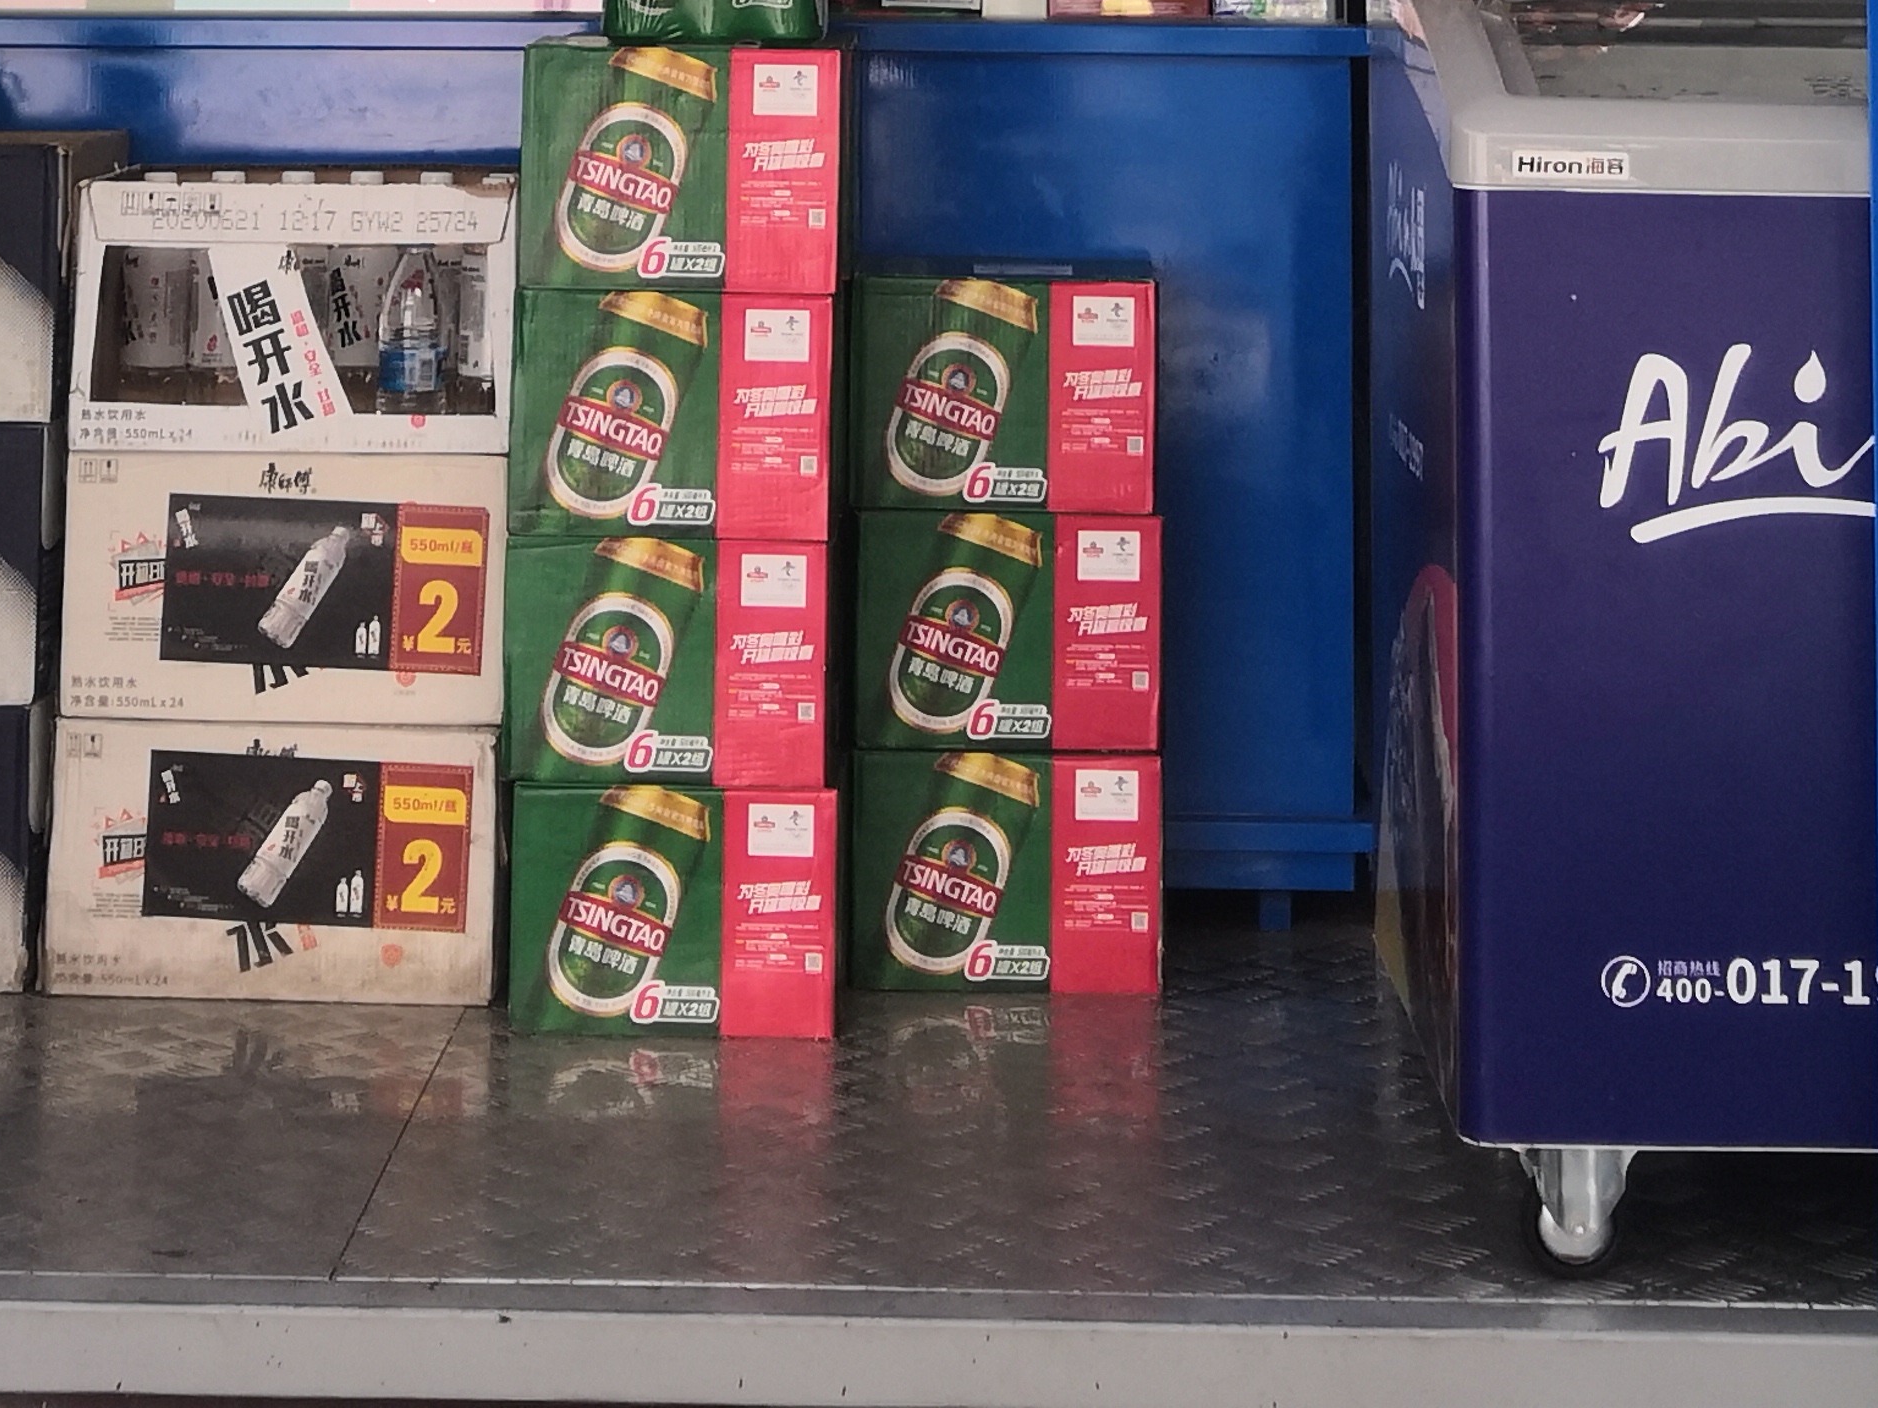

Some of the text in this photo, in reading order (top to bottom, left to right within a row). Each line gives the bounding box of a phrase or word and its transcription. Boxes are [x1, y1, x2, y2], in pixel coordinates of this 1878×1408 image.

[576, 156, 673, 209] TSINGTAO
[226, 278, 315, 435] 喝开水
[564, 398, 662, 456] TSINGTAO
[901, 380, 998, 435] TSINGTAO
[561, 645, 660, 702] TSINGTAO
[903, 619, 1001, 673] TSINGTAO
[901, 861, 998, 913] TSINGTAO
[567, 897, 667, 952] TSINGTAO
